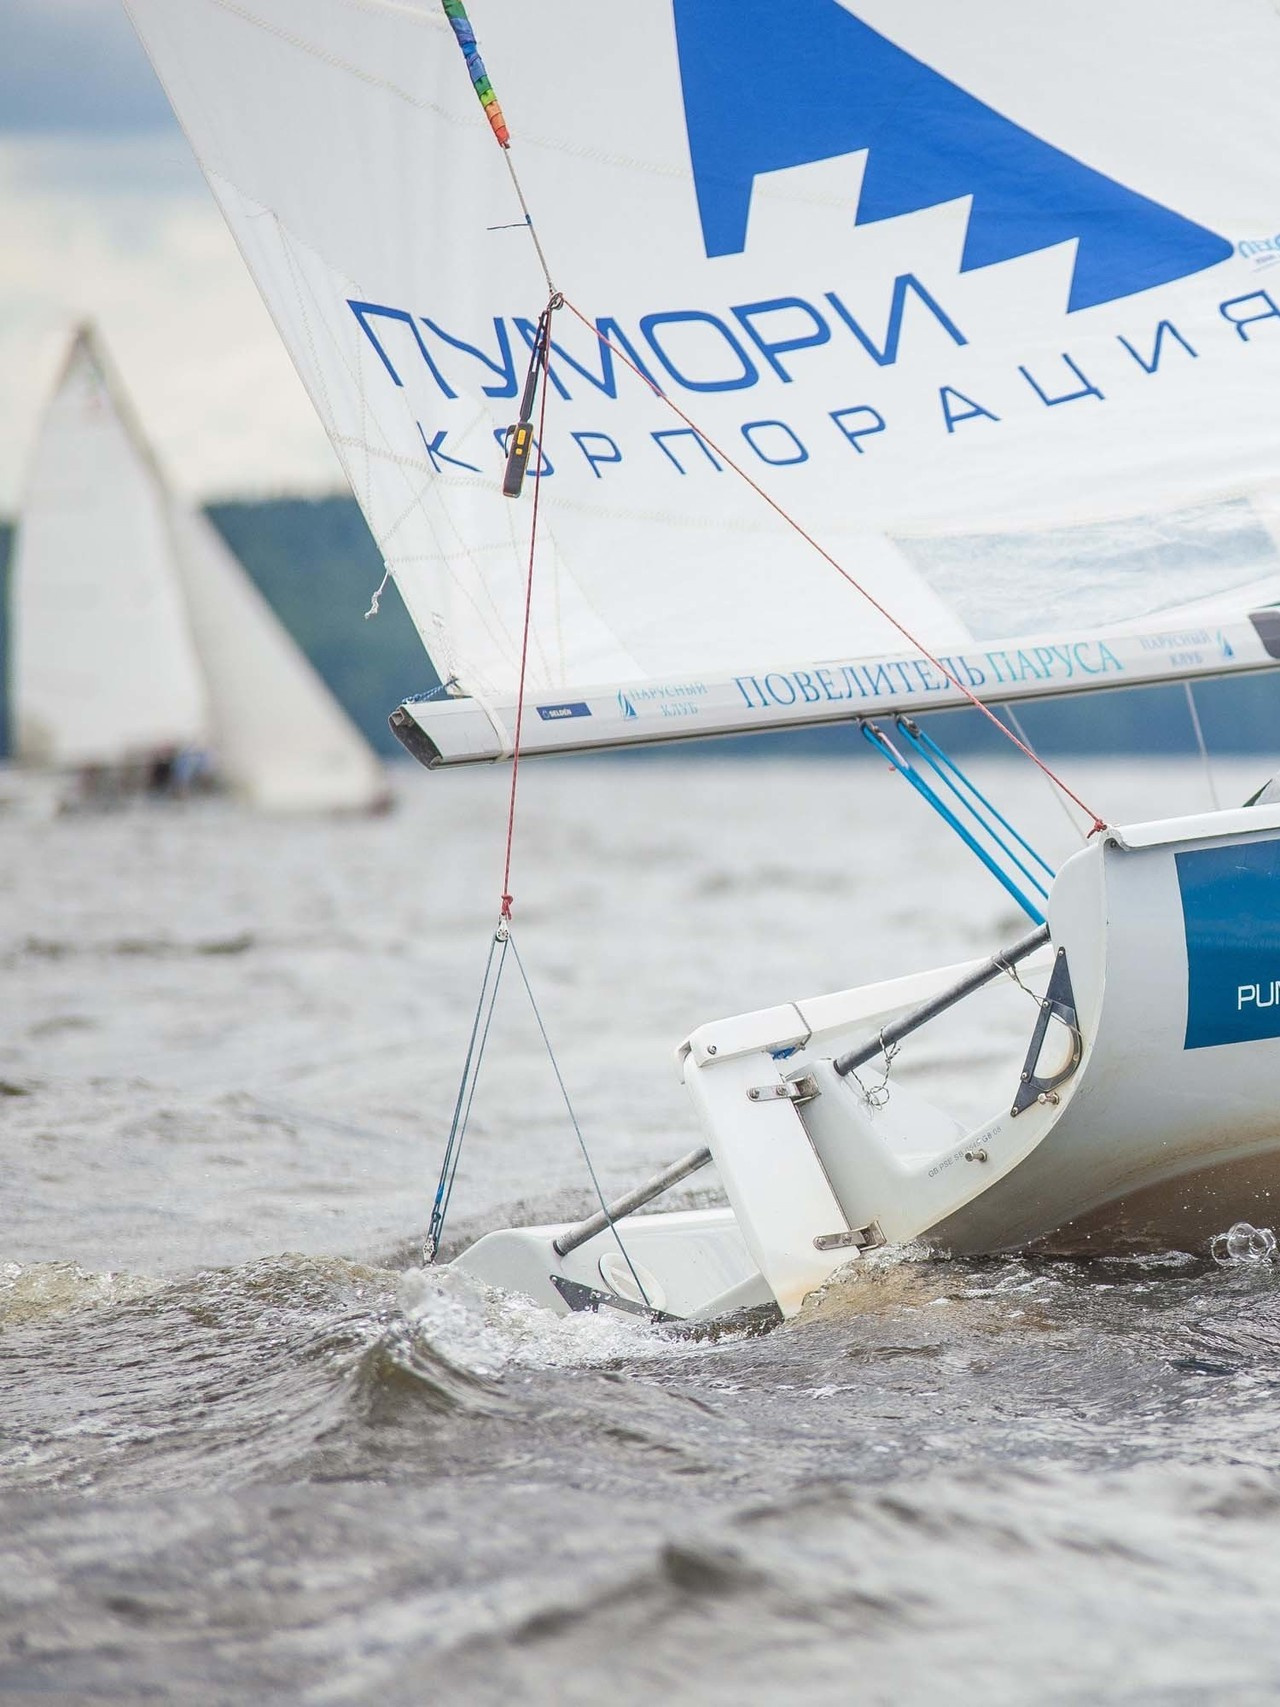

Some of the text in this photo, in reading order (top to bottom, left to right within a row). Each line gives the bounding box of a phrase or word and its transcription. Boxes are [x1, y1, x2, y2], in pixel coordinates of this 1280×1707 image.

[346, 272, 969, 400] ПУМОРИ
[629, 681, 708, 700] ПАРУСНЫЙ
[731, 641, 1124, 709] ПОВЕЛИТЕЛЬ ПАРУСА
[660, 701, 699, 717] КЛУБ
